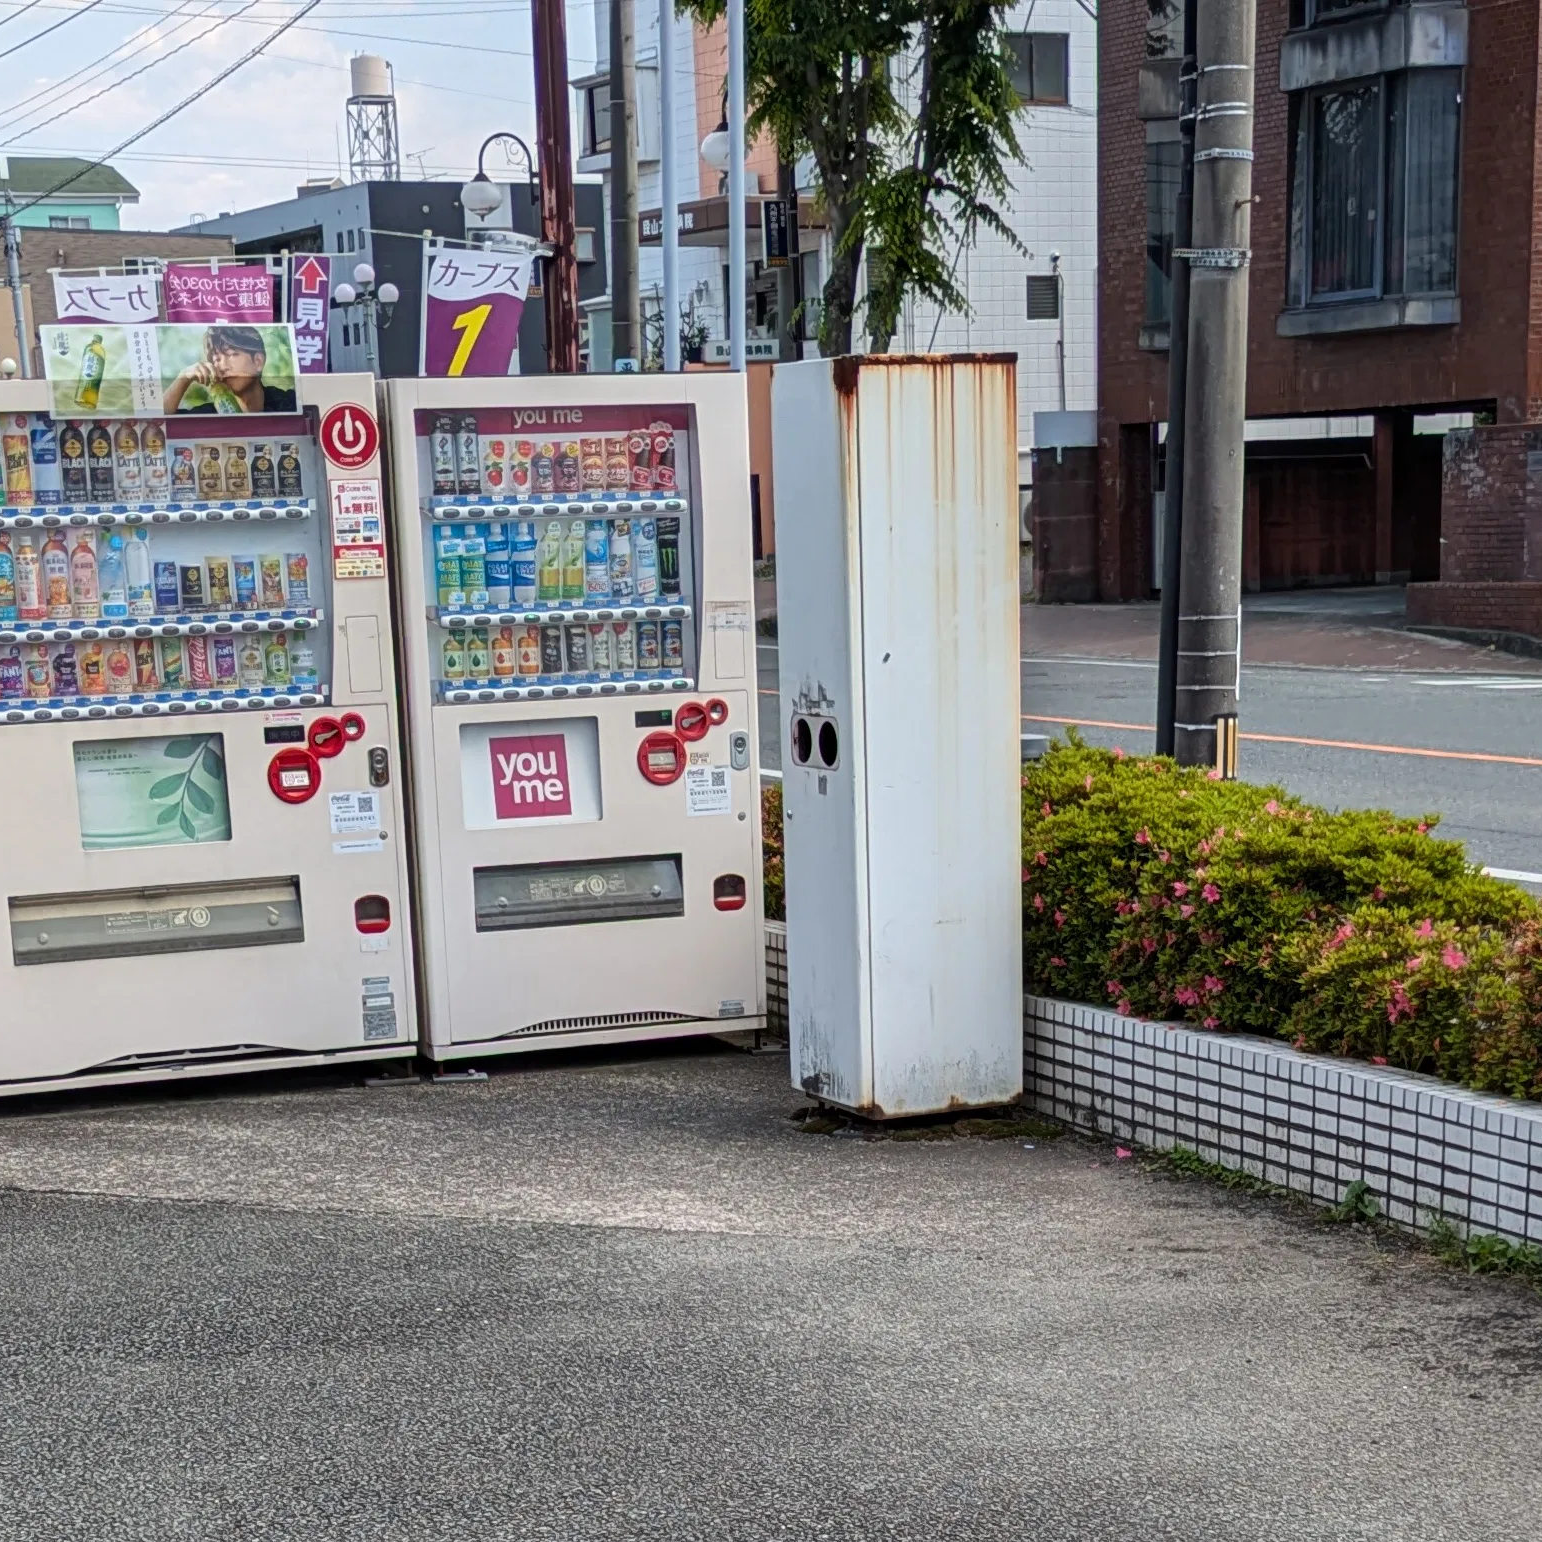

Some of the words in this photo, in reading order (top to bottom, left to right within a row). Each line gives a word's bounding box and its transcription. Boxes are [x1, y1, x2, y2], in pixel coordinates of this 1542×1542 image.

[433, 258, 521, 292] カーブス
[296, 298, 325, 366] 見学
[447, 304, 493, 376] 1
[513, 409, 547, 429] you
[553, 408, 583, 424] me
[496, 751, 558, 785] you
[513, 778, 564, 804] me
